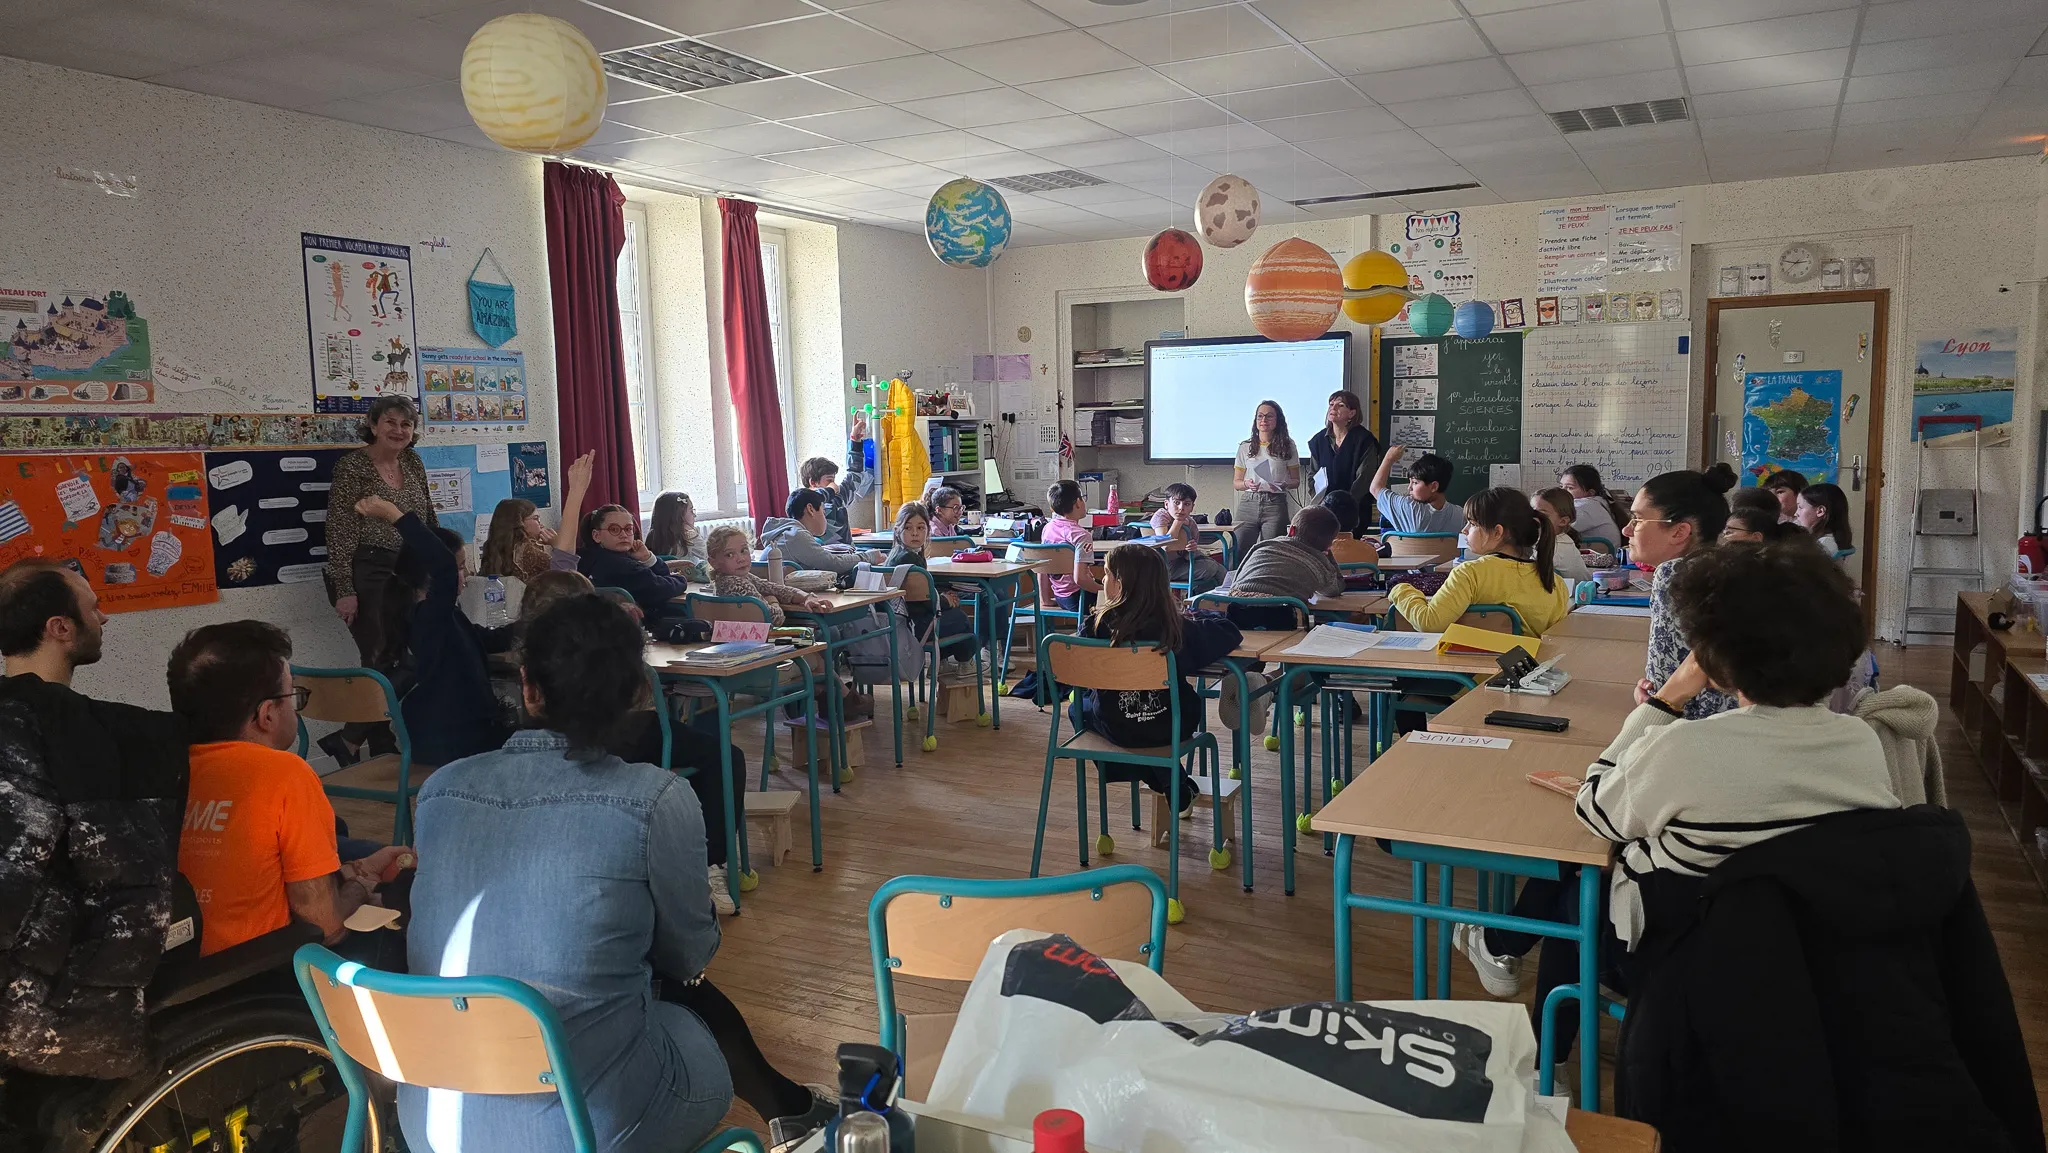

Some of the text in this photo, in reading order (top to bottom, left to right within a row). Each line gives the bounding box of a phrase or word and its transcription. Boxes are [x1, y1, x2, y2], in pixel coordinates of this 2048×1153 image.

[1587, 204, 1606, 212] travail
[303, 236, 317, 247] MON
[319, 237, 342, 249] PREMIER
[344, 241, 380, 254] VOCABULAIRE
[1538, 245, 1565, 253] d'activité
[1544, 277, 1569, 285] Illustrer
[478, 296, 509, 310] YOU ARE
[476, 310, 511, 328] AMAZING
[1939, 338, 1992, 357] Lyon
[1767, 375, 1804, 385] LA FRANCE
[1459, 405, 1513, 414] SCIENCES
[1453, 436, 1500, 445] HISTOIRE
[1462, 465, 1489, 475] EMC
[182, 583, 214, 593] EMILIE
[1419, 733, 1493, 745] ARTHUR
